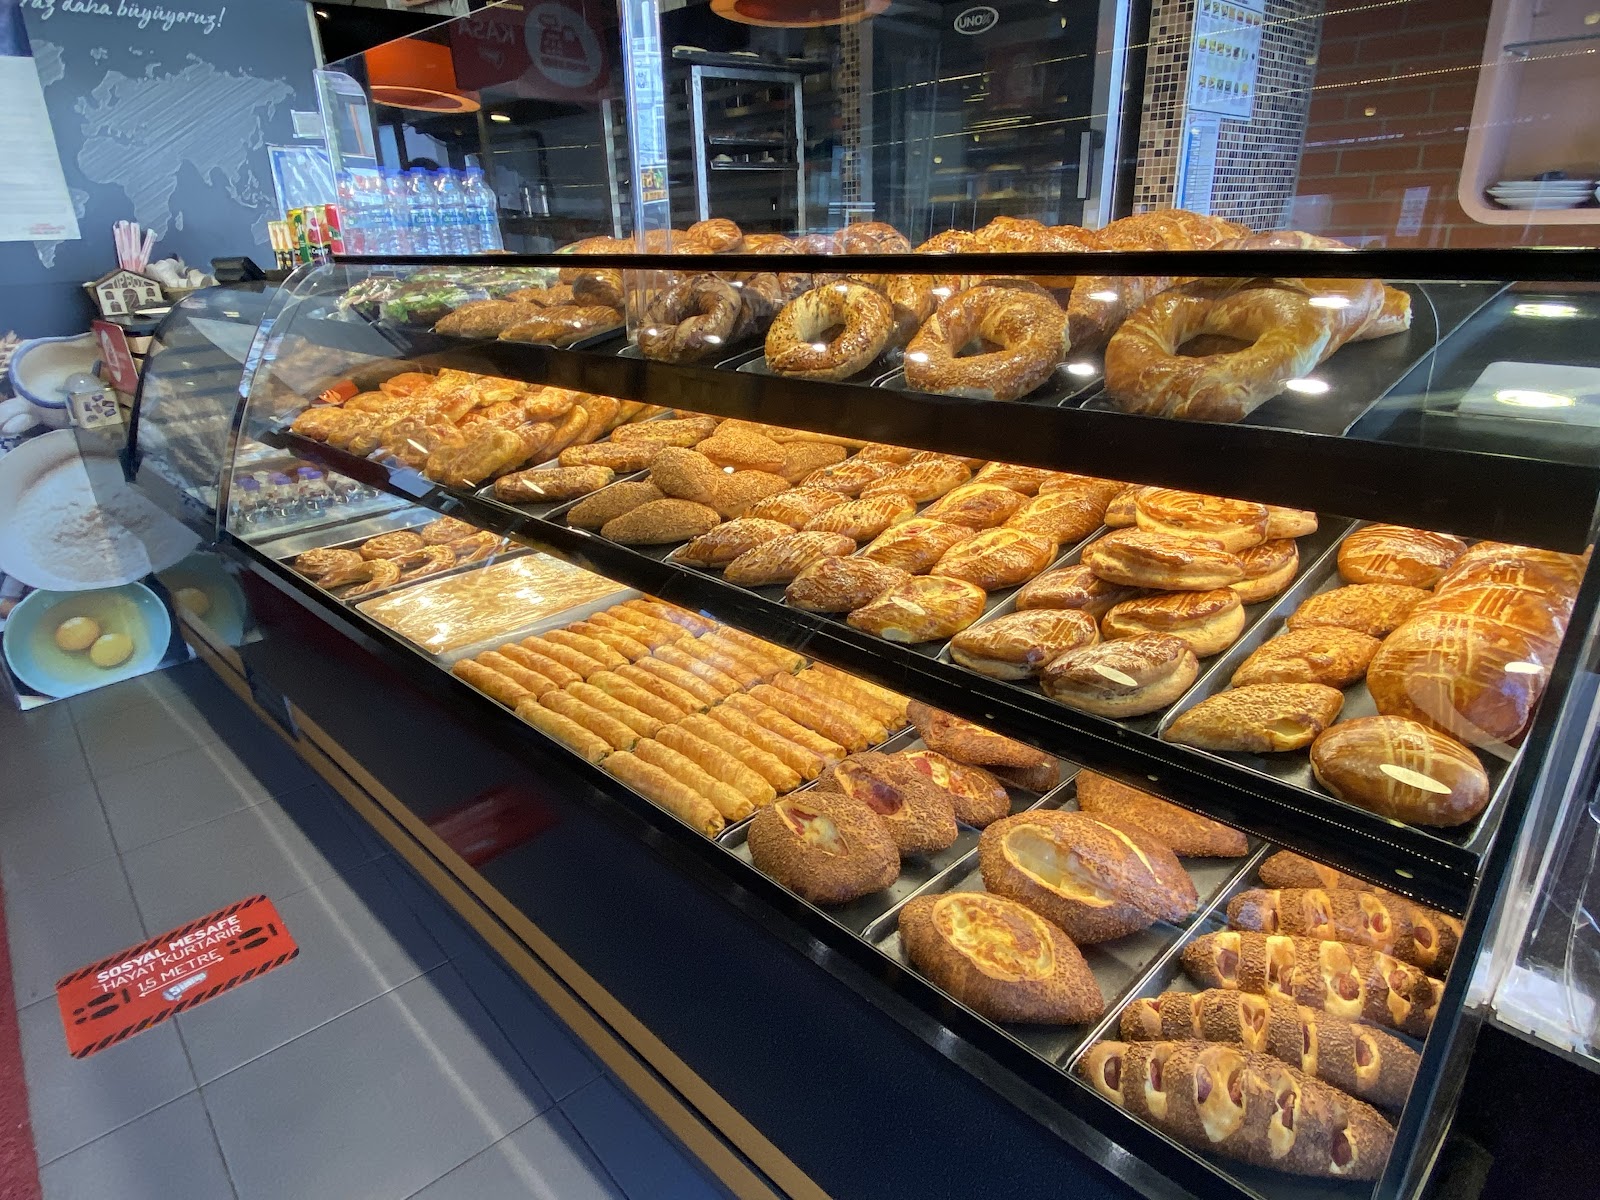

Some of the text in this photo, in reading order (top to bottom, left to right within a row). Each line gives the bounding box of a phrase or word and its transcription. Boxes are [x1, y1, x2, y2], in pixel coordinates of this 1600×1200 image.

[62, 0, 112, 15] daha
[117, 0, 226, 34] büyüyoruz!
[97, 915, 241, 984] SOSYAL MESAFE
[101, 963, 155, 993] HAYAT
[161, 924, 243, 965] KURTARIR
[160, 948, 219, 982] METRE
